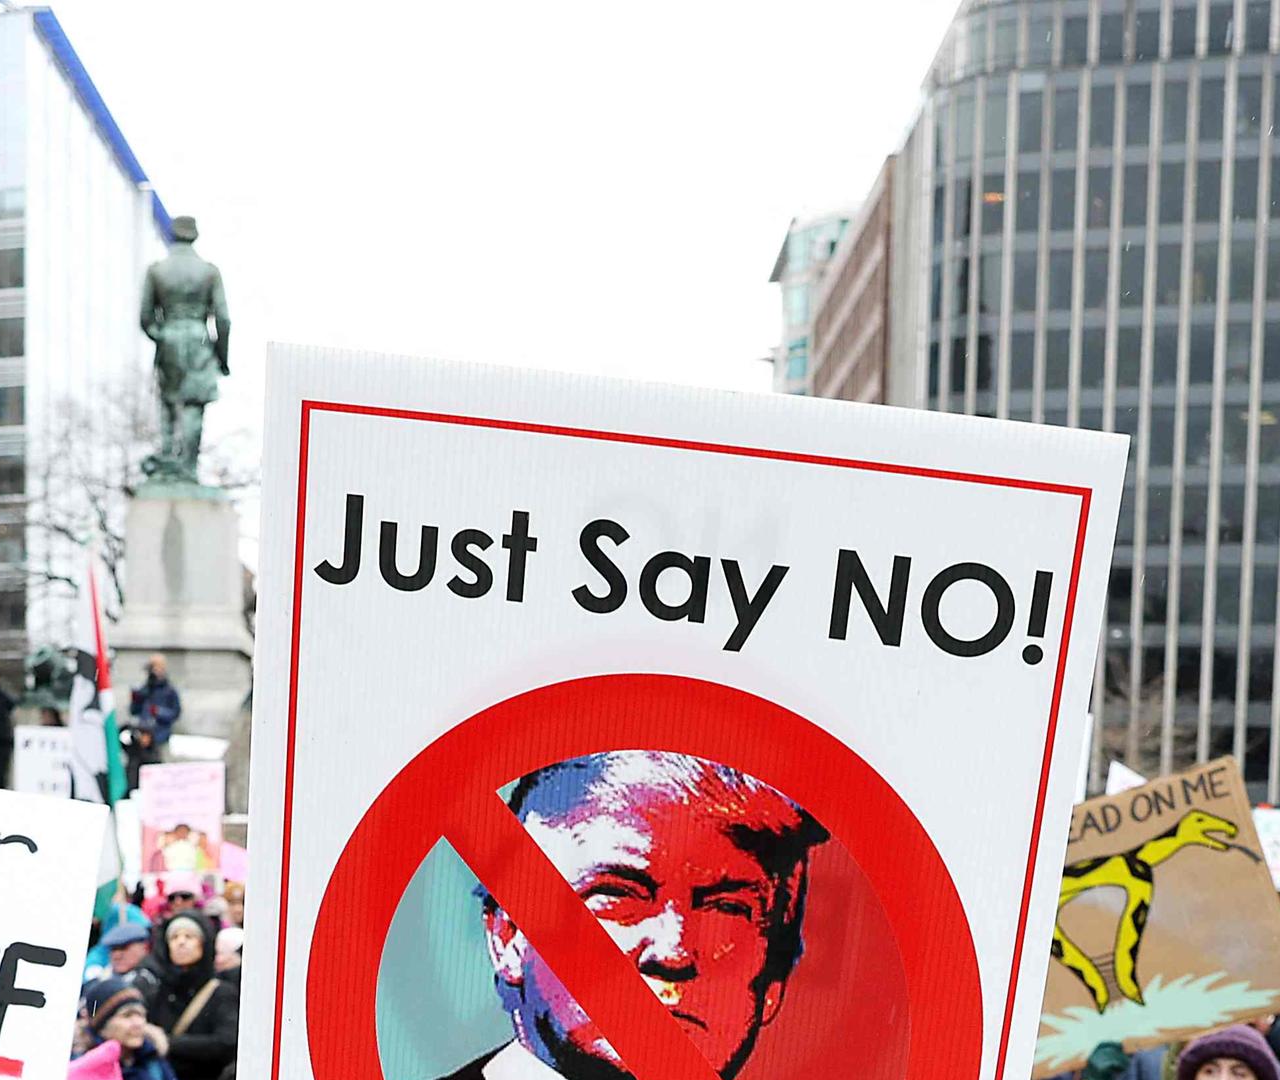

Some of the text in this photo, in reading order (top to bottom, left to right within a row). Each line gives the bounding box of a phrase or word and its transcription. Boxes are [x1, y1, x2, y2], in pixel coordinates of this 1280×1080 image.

[314, 494, 1055, 666] Just Say NO!
[1130, 785, 1176, 821] ON
[1181, 766, 1230, 805] ME
